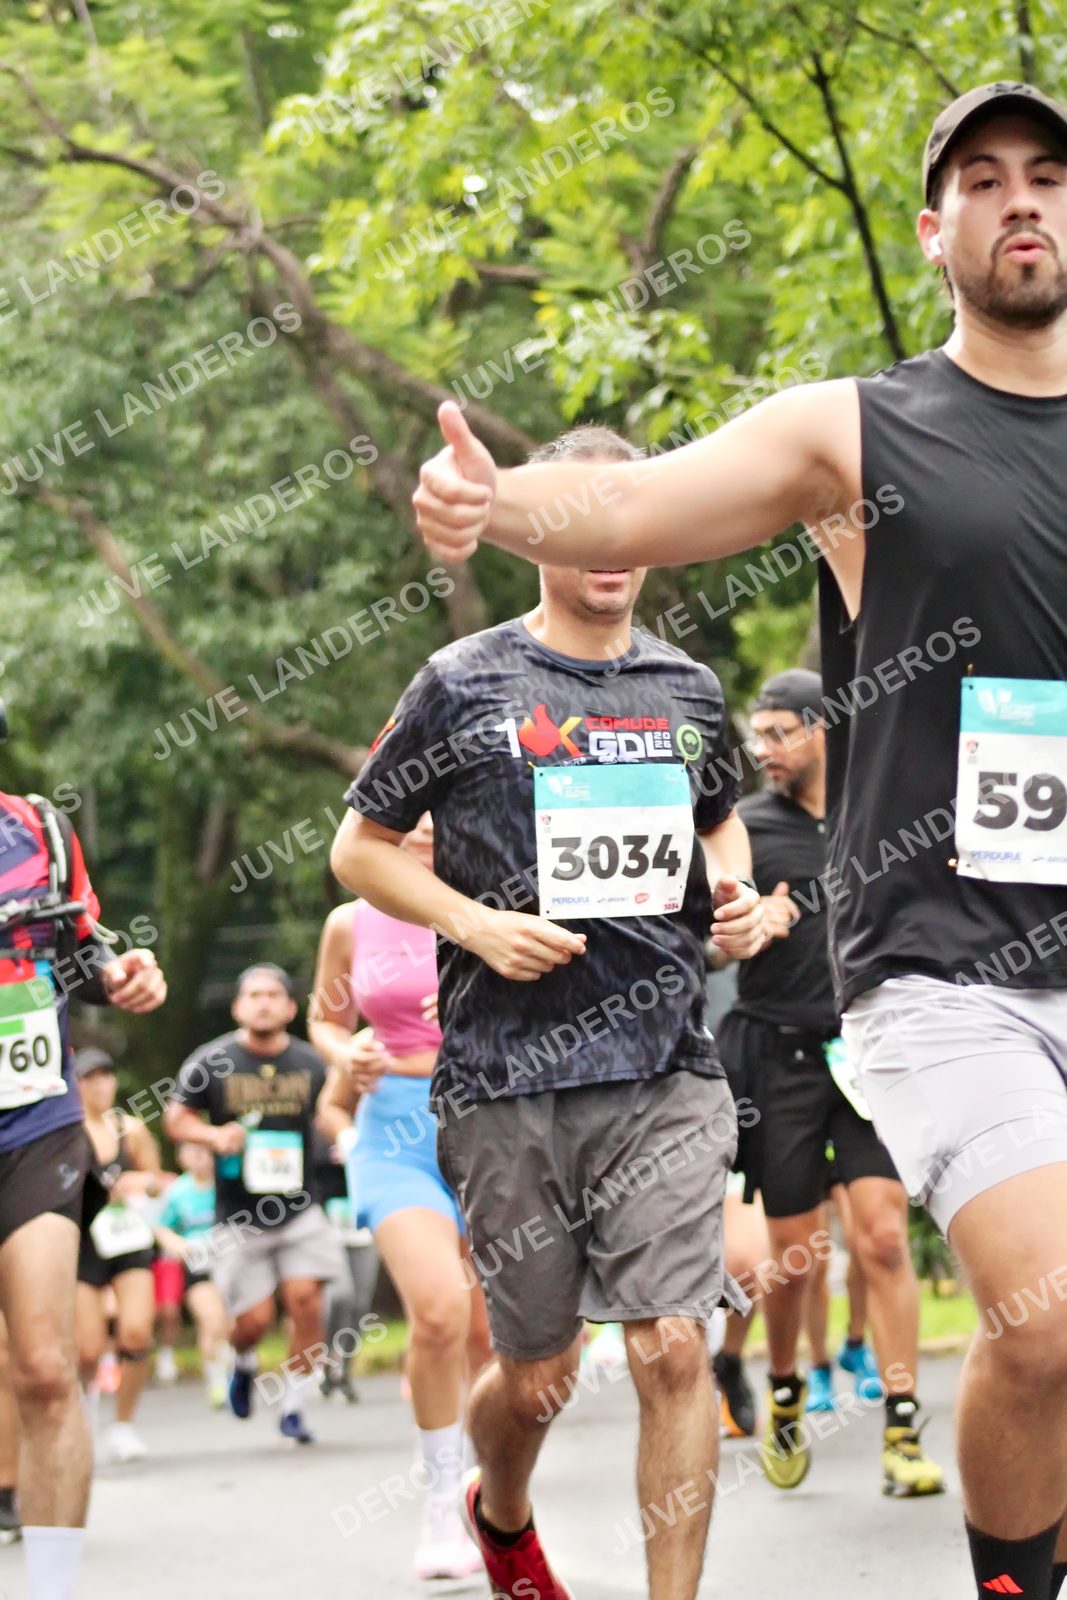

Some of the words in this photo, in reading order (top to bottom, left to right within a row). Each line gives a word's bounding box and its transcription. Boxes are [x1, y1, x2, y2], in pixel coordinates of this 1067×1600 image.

[585, 716, 670, 731] COMUDE
[589, 731, 672, 760] GDL
[973, 771, 1066, 832] 59
[551, 834, 681, 881] 3034
